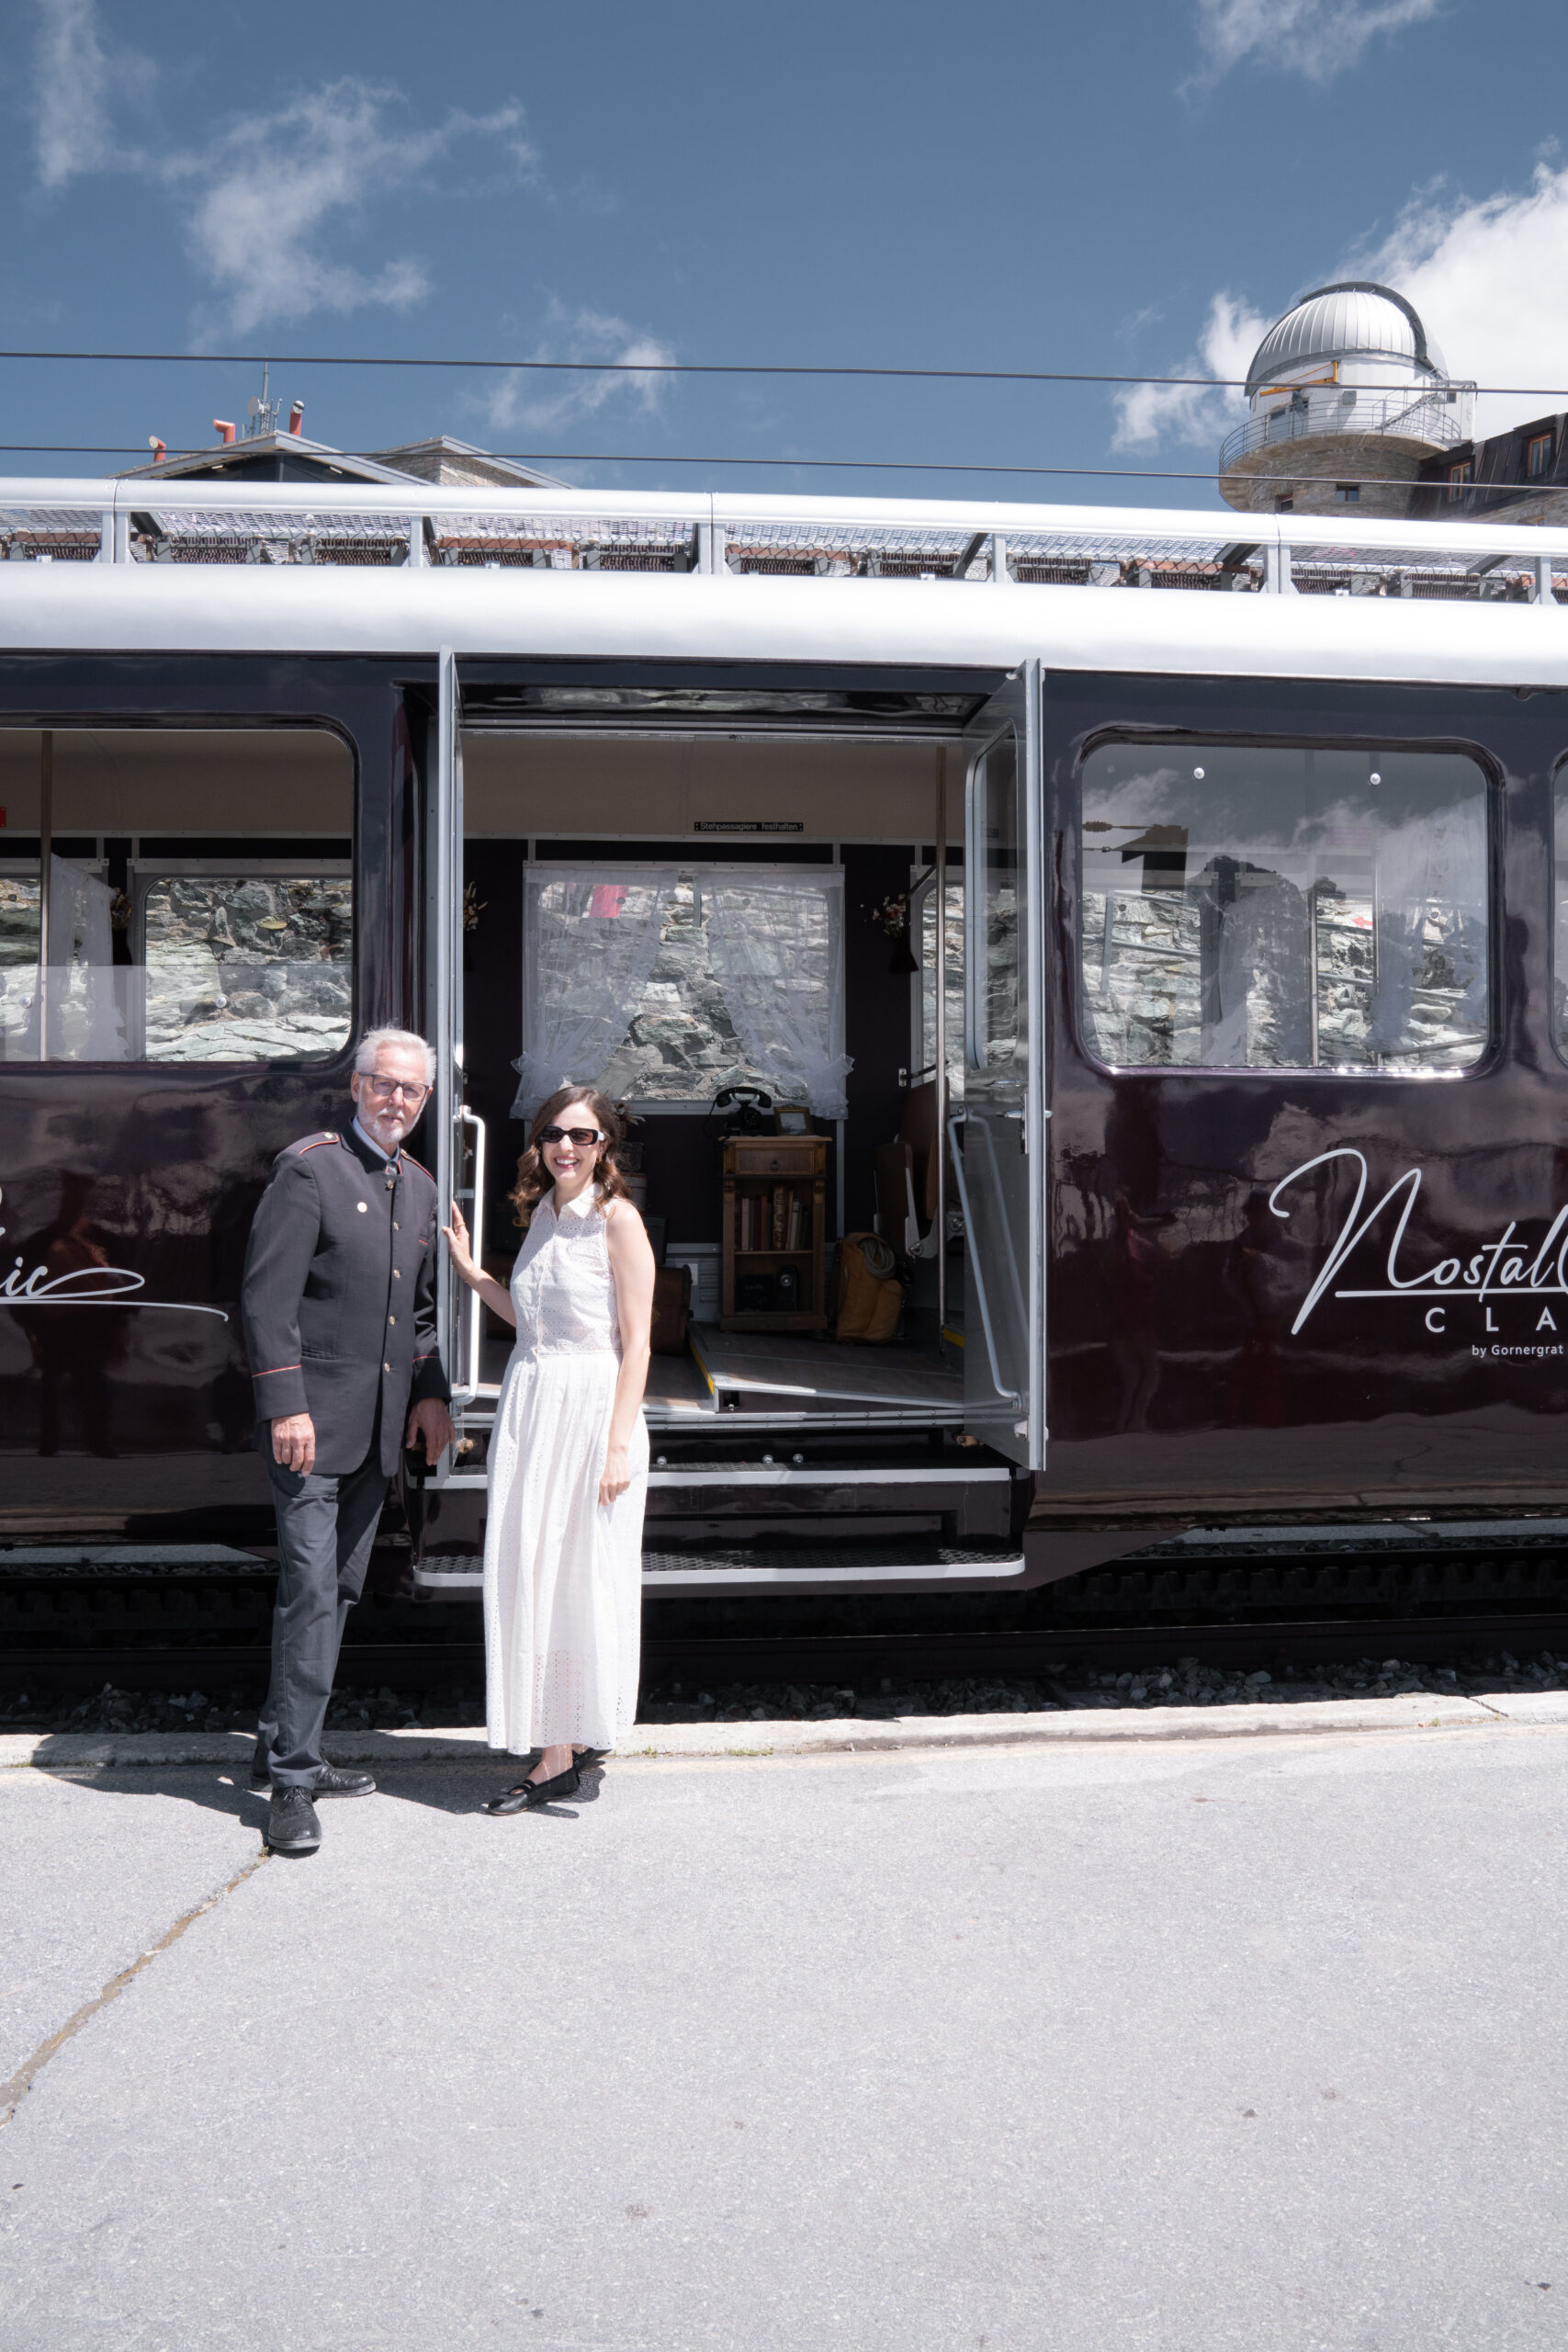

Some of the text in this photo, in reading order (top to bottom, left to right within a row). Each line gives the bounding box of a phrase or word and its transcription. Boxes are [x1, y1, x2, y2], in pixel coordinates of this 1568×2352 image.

[700, 821, 798, 831] Stehpassagiere festhalten
[1269, 1148, 1568, 1335] Nostal
[1472, 1344, 1564, 1358] by Gornergrat
